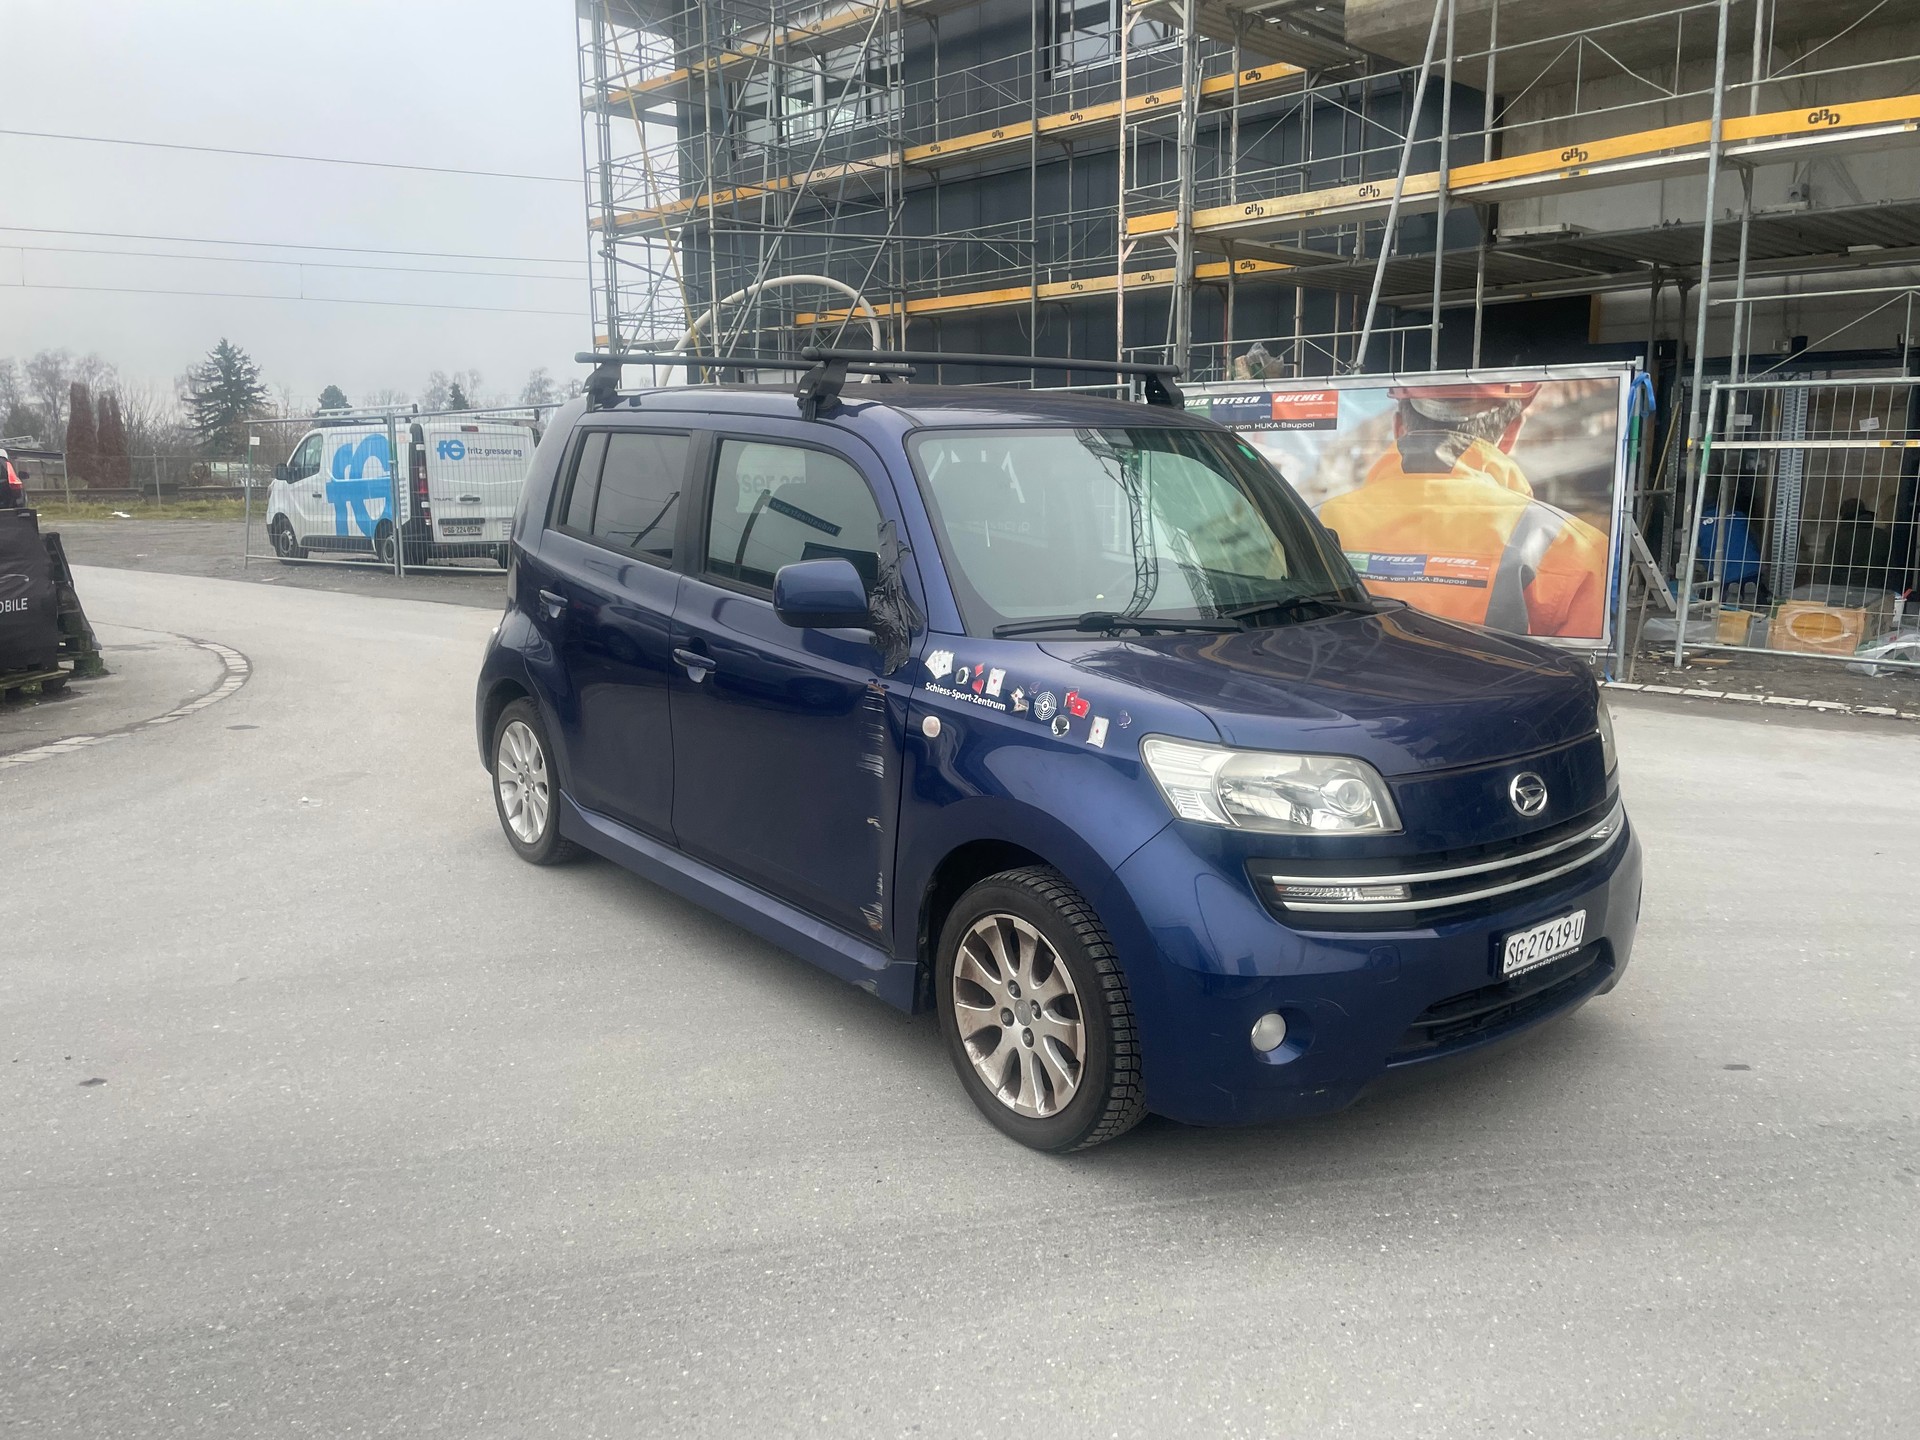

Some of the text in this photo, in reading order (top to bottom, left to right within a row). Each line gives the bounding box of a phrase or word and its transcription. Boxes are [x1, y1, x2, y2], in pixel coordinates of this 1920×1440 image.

[1245, 71, 1261, 82] GBD
[1145, 95, 1160, 105] GBD
[1070, 112, 1084, 122] GBD
[1807, 109, 1841, 125] GBD
[1561, 147, 1589, 163] GBD
[1359, 185, 1381, 198] GBD
[1245, 204, 1264, 217] GBD
[1240, 260, 1256, 270] GBD
[1141, 273, 1155, 282] GBD
[1070, 282, 1084, 291] GBD
[1212, 396, 1259, 405] VETSCH
[467, 446, 523, 458] fritz gresser ag
[925, 681, 1006, 711] Schiess-Sport-Zentrum
